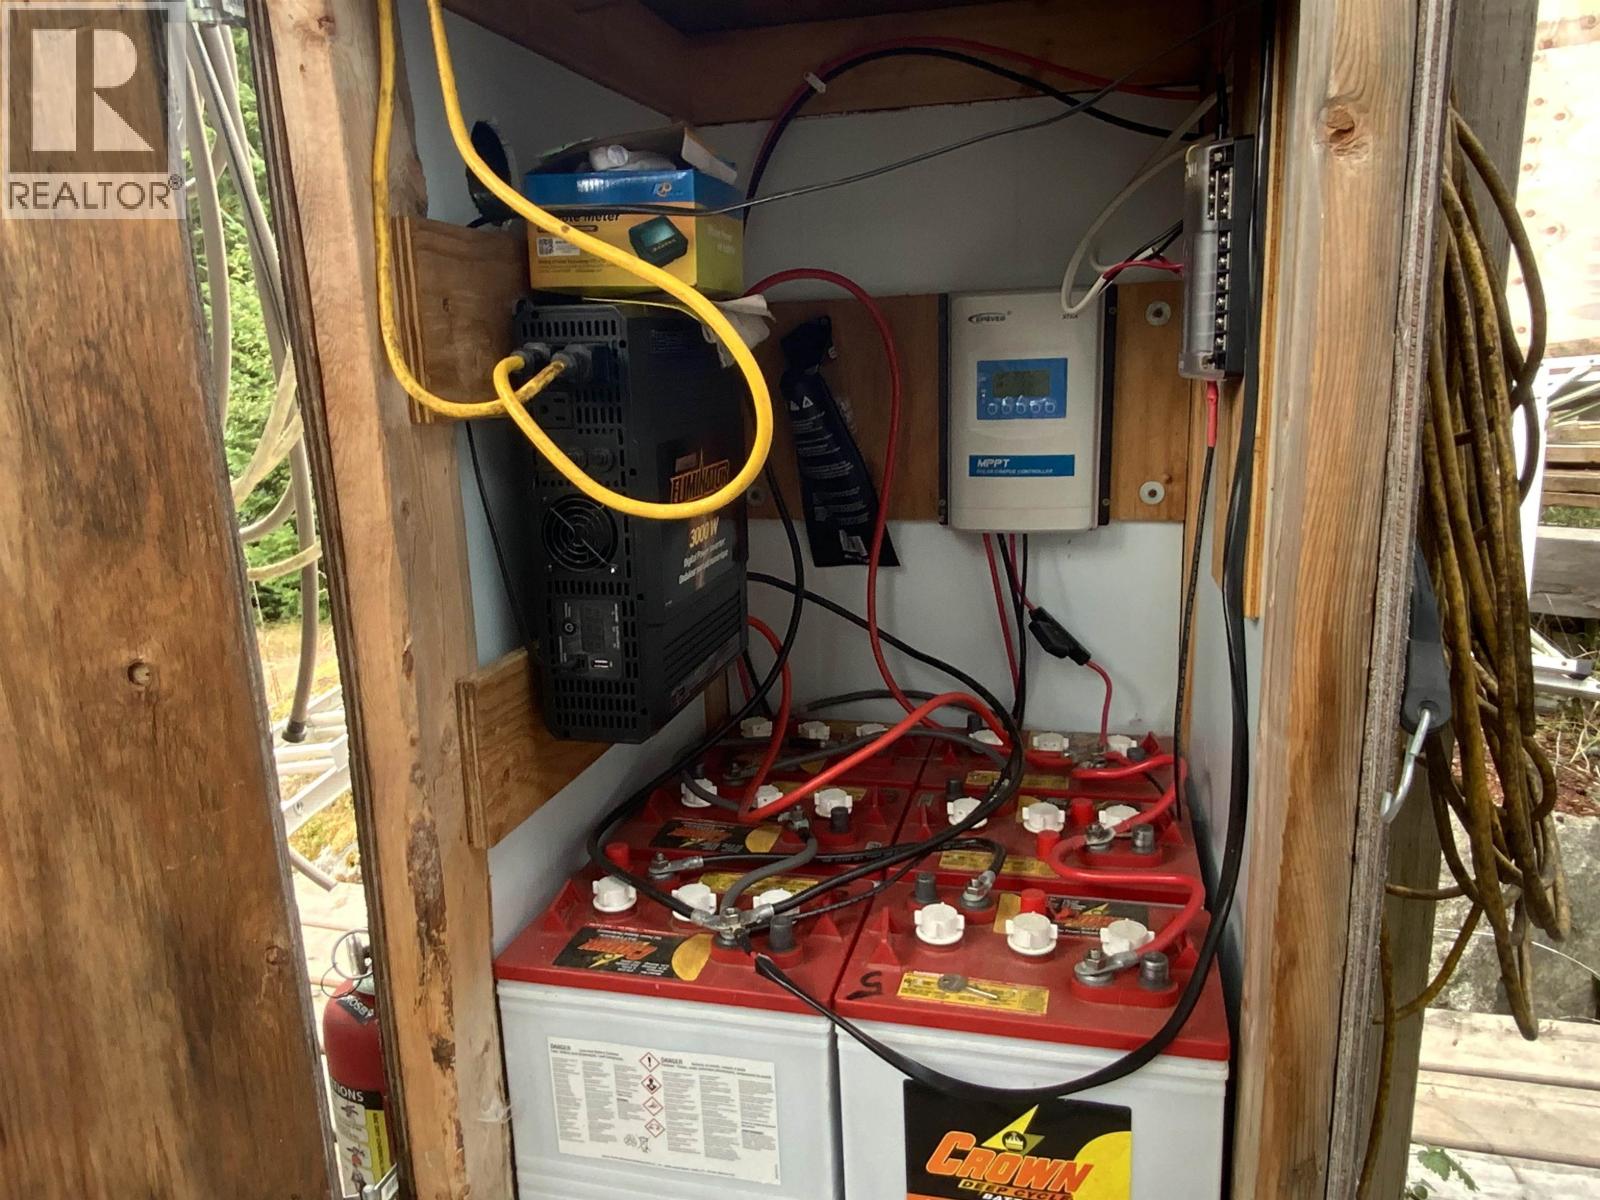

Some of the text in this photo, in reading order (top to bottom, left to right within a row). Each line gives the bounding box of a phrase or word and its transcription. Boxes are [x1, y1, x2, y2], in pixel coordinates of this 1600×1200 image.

[977, 458, 1011, 468] MPPT
[689, 521, 710, 549] 3000
[926, 1131, 1094, 1193] CROWN
[960, 1180, 1009, 1197] DEEP
